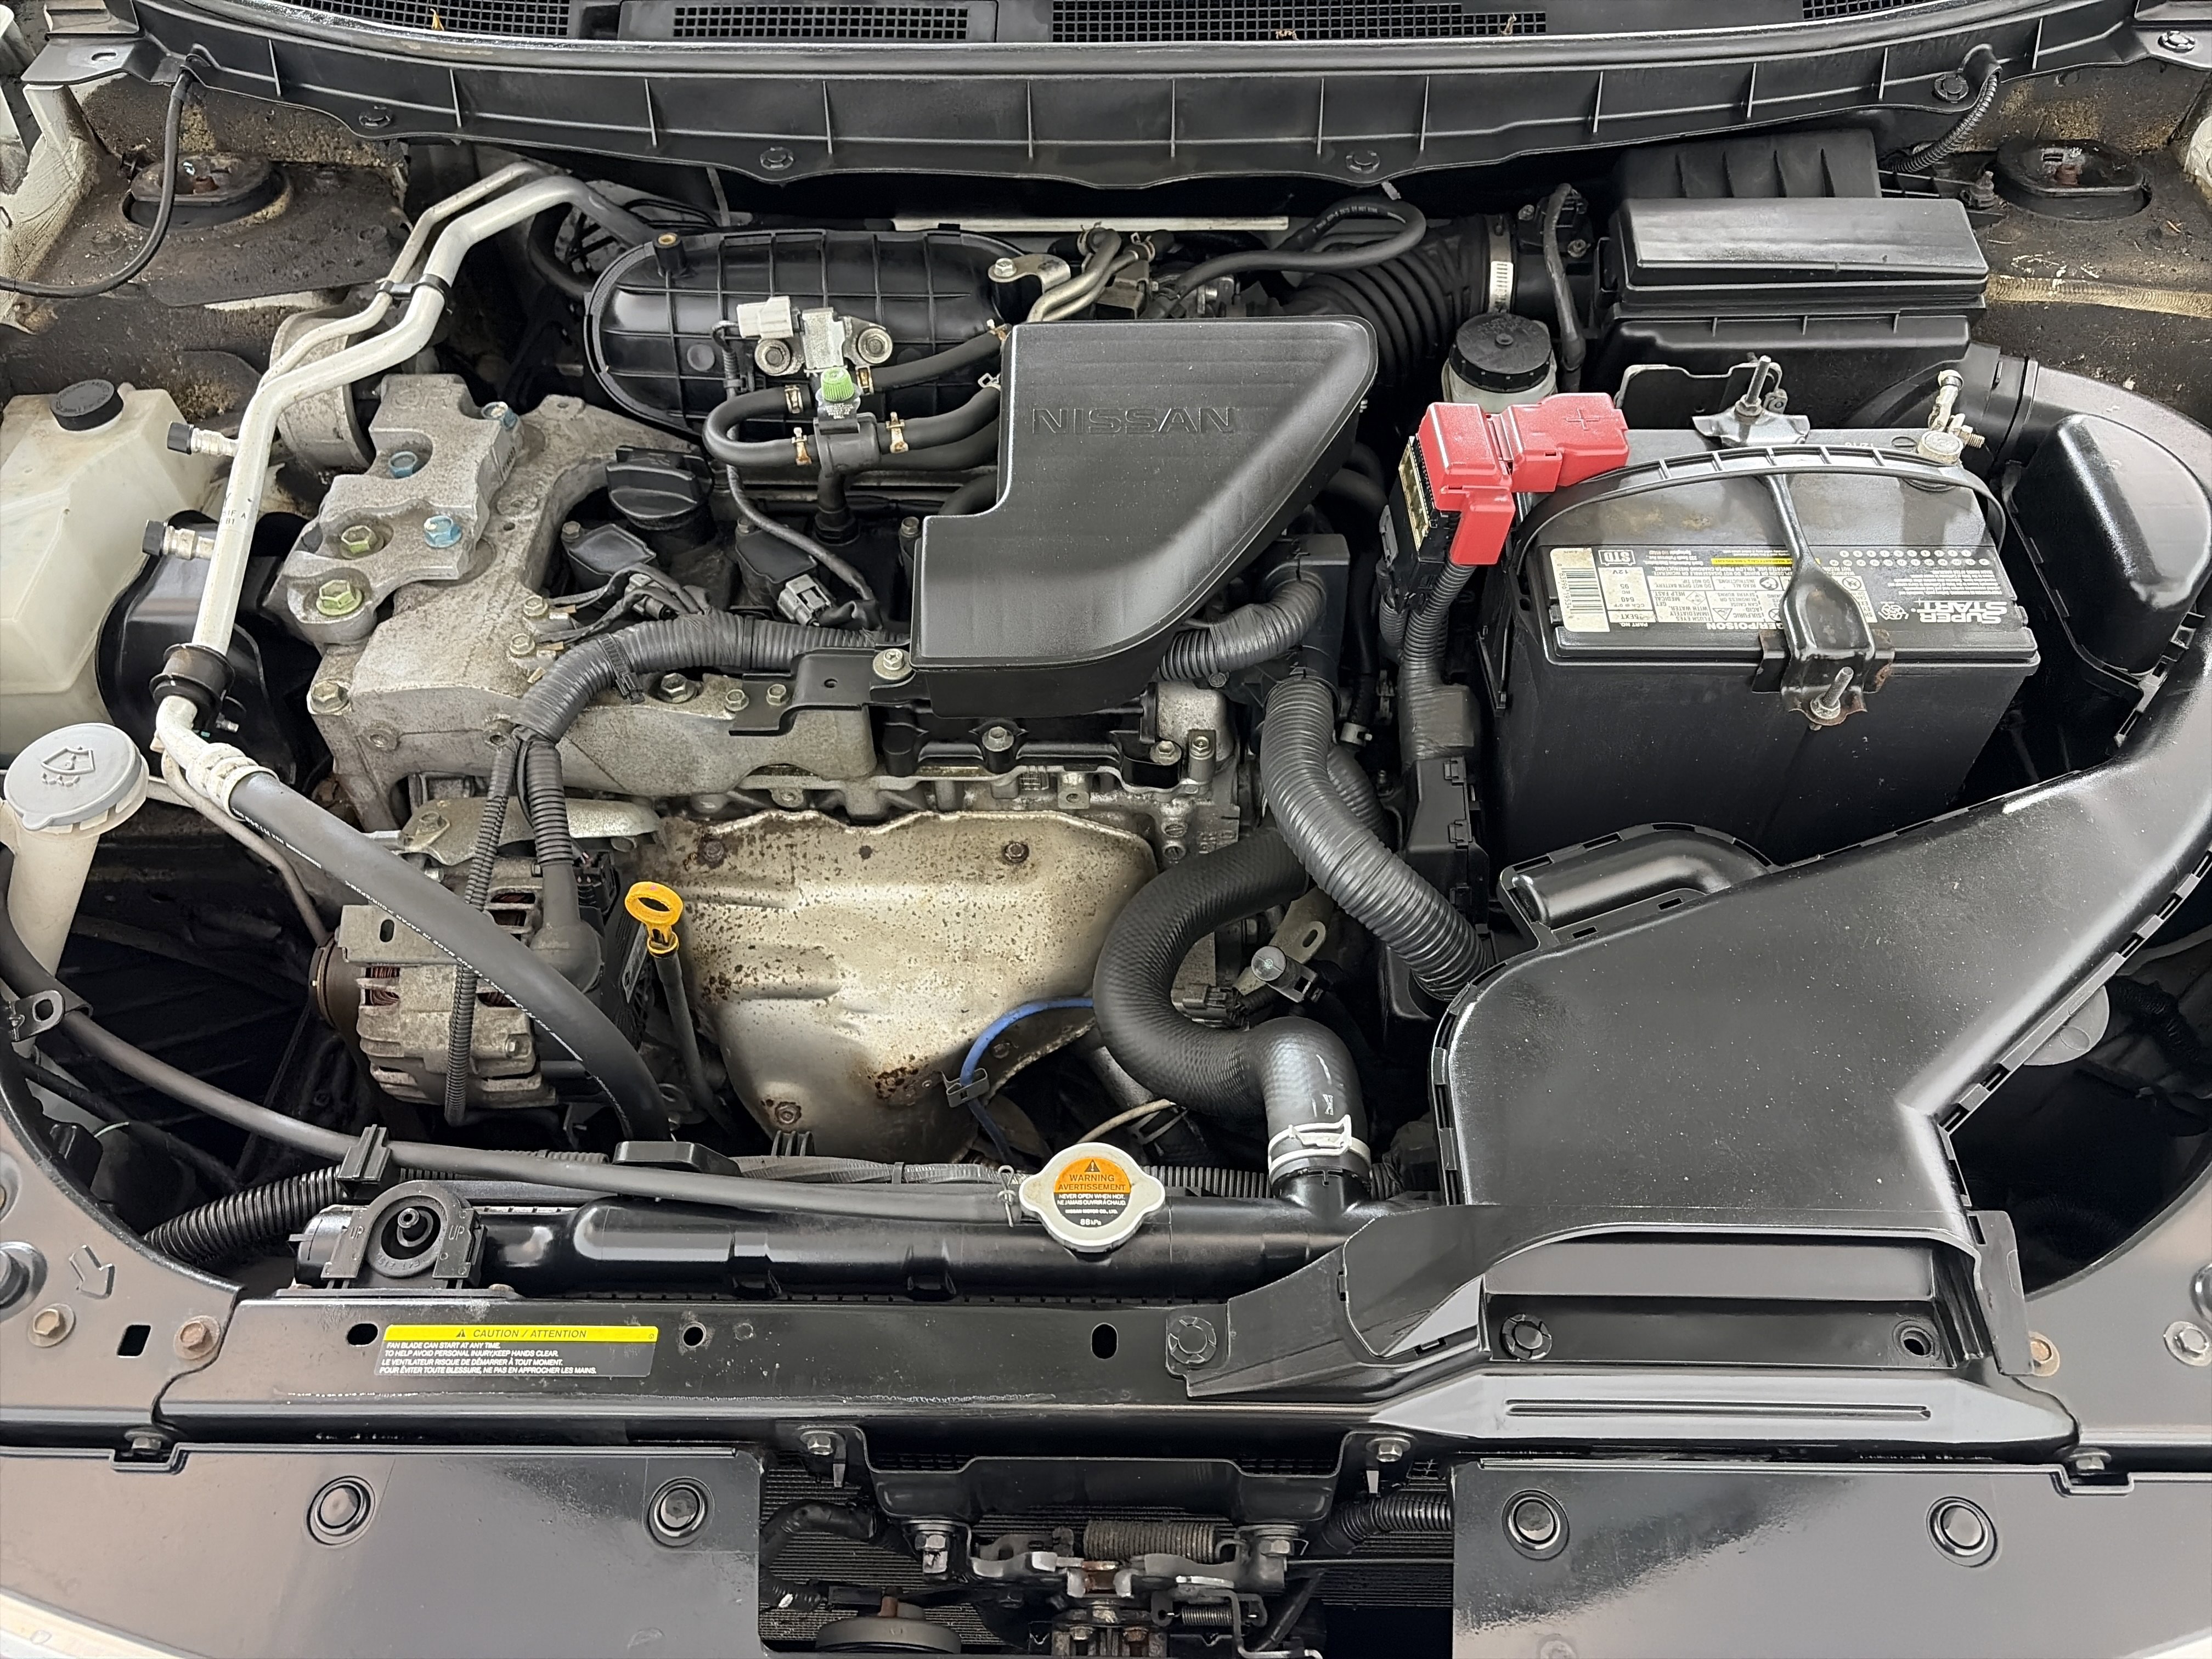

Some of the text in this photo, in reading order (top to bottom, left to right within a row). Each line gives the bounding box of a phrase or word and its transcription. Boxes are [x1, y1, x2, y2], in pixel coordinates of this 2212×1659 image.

[1032, 407, 1235, 435] NISSAN
[1604, 552, 1630, 562] STD
[1916, 601, 2007, 614] START
[1920, 612, 2001, 624] SUPER
[396, 914, 421, 933] JAPAN
[433, 940, 455, 957] MADE
[484, 977, 506, 995] ONLY
[350, 1225, 365, 1239] UP
[448, 1224, 465, 1241] UP
[473, 1329, 587, 1338] CAUTION / ATTENTION
[472, 1357, 507, 1365] DÉMARRER
[508, 1357, 514, 1365] À
